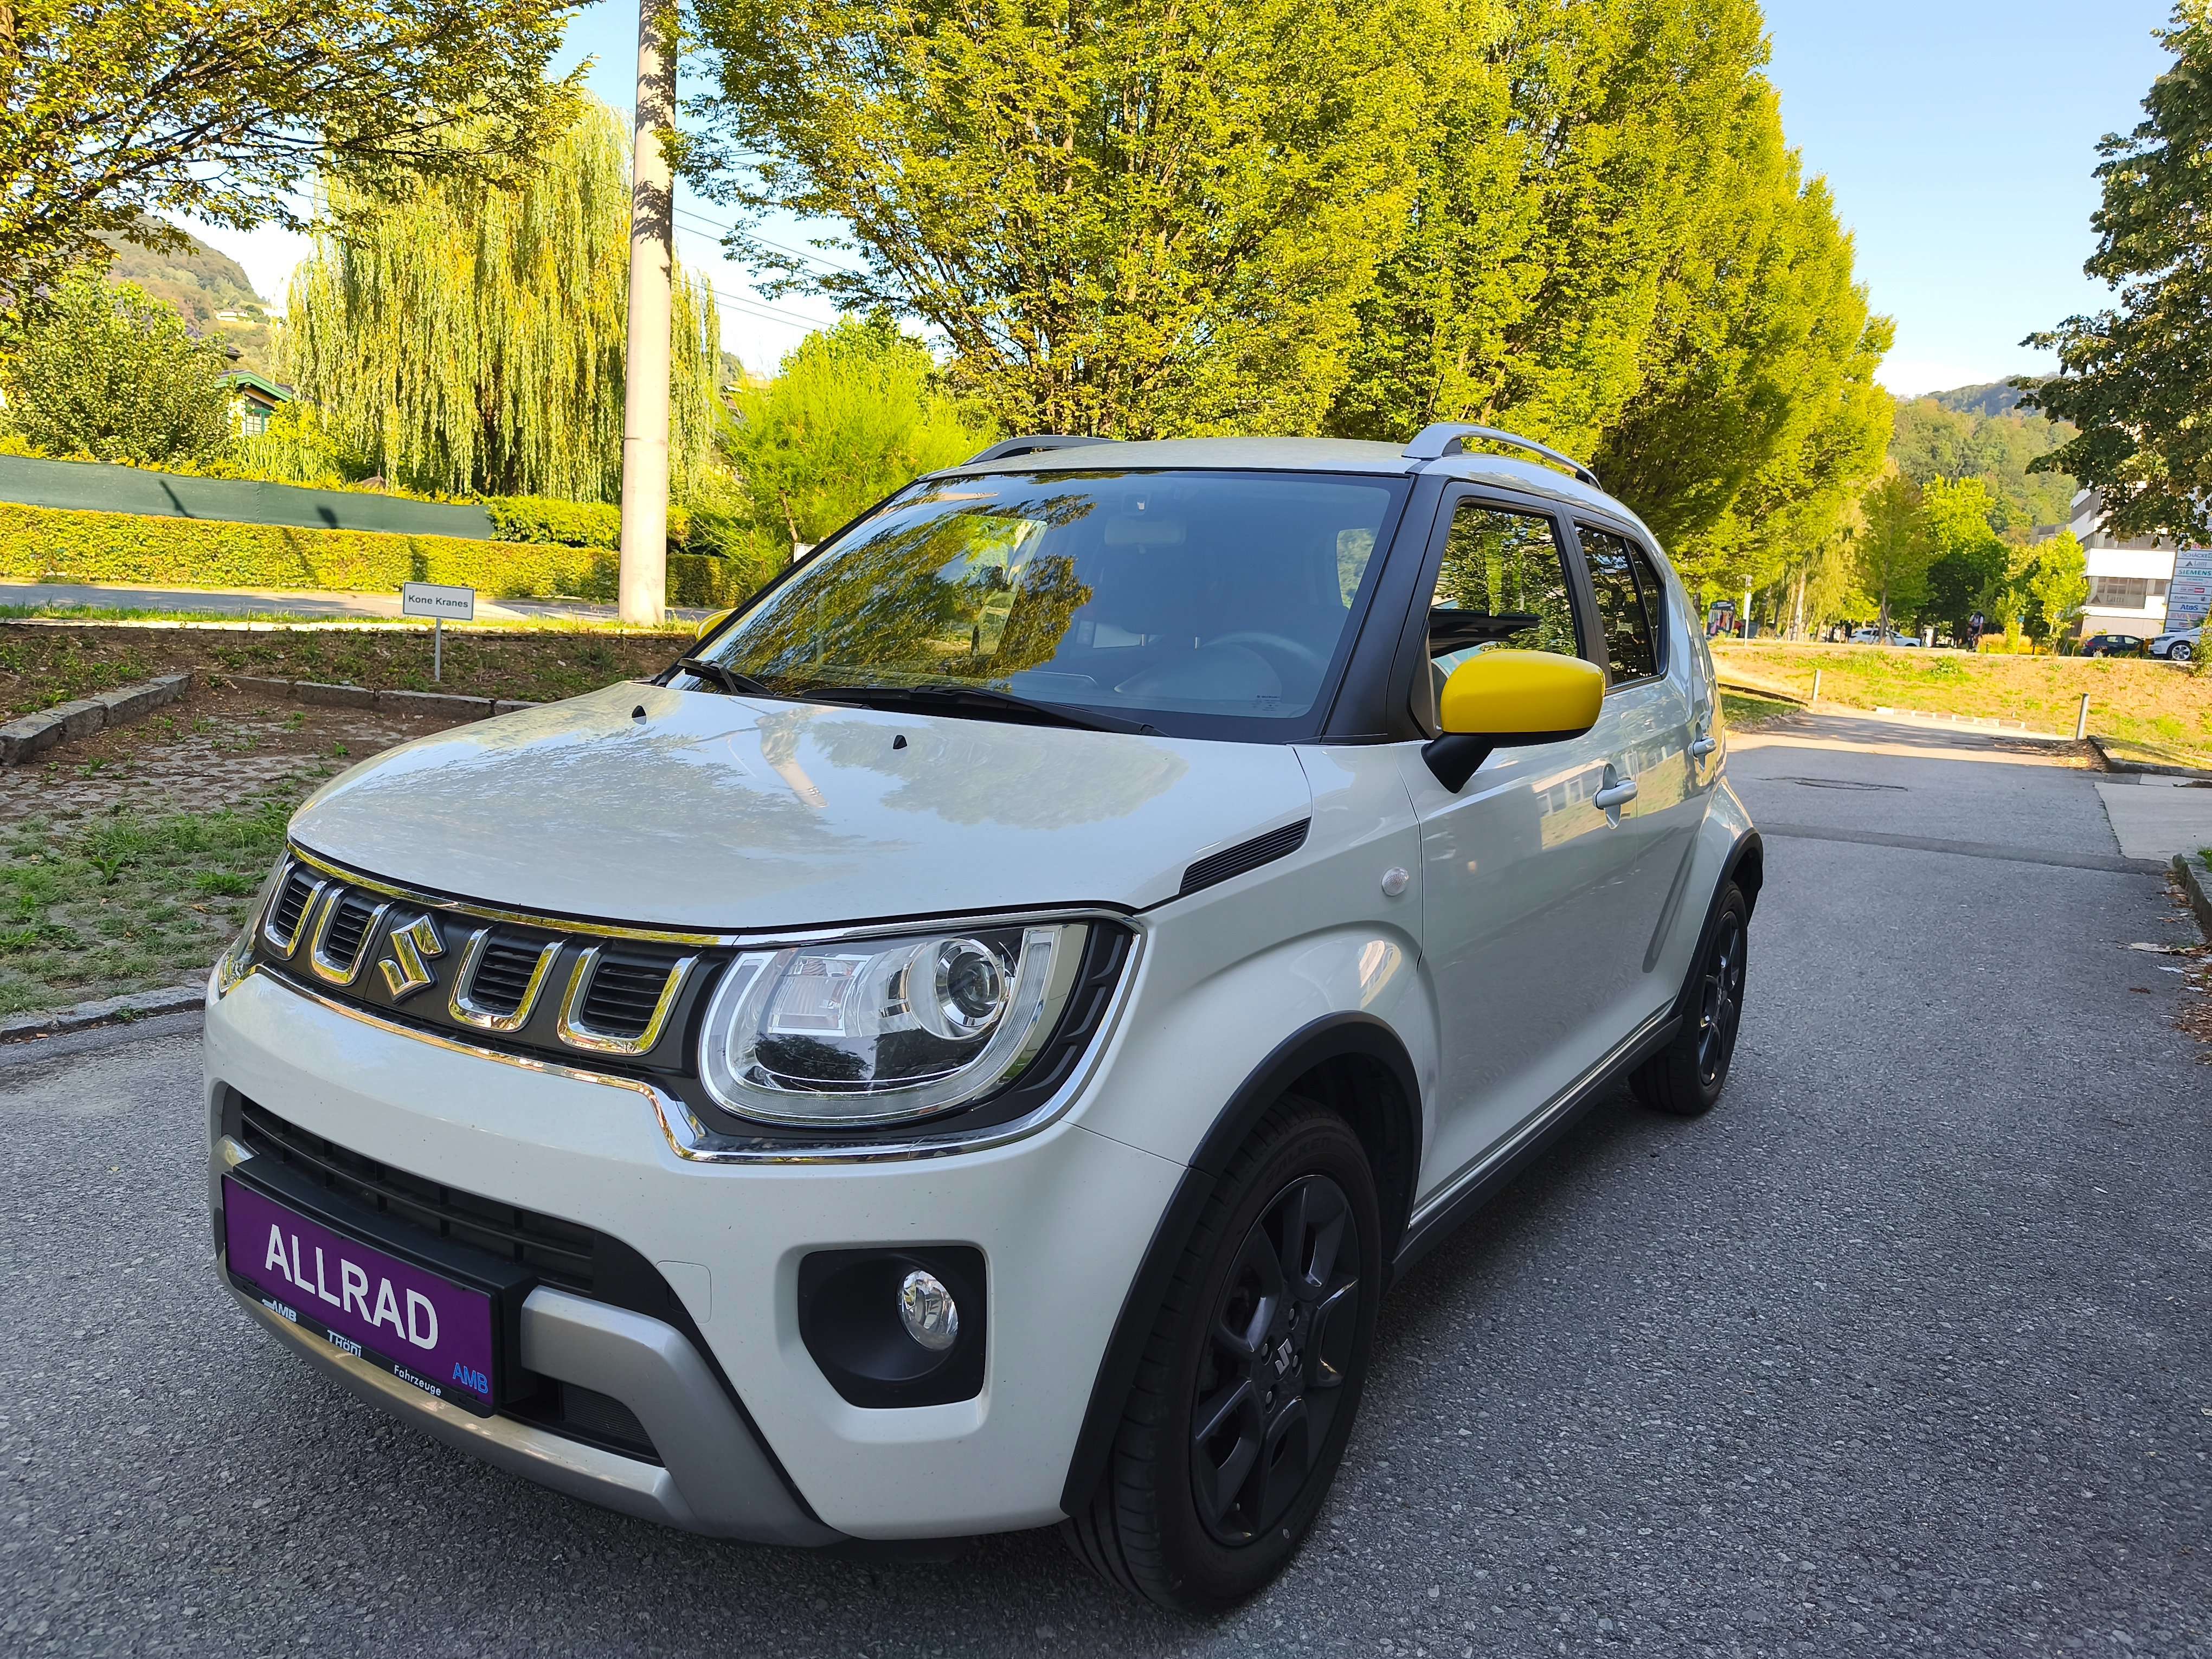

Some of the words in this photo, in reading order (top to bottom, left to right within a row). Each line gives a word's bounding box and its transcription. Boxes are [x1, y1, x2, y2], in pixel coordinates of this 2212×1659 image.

[409, 595, 433, 604] Kone
[436, 597, 468, 608] Kranes
[265, 1224, 438, 1350] ALLRAD
[262, 1299, 297, 1323] AMB
[394, 1365, 441, 1396] Fahrzeuge
[452, 1362, 488, 1394] AMB
